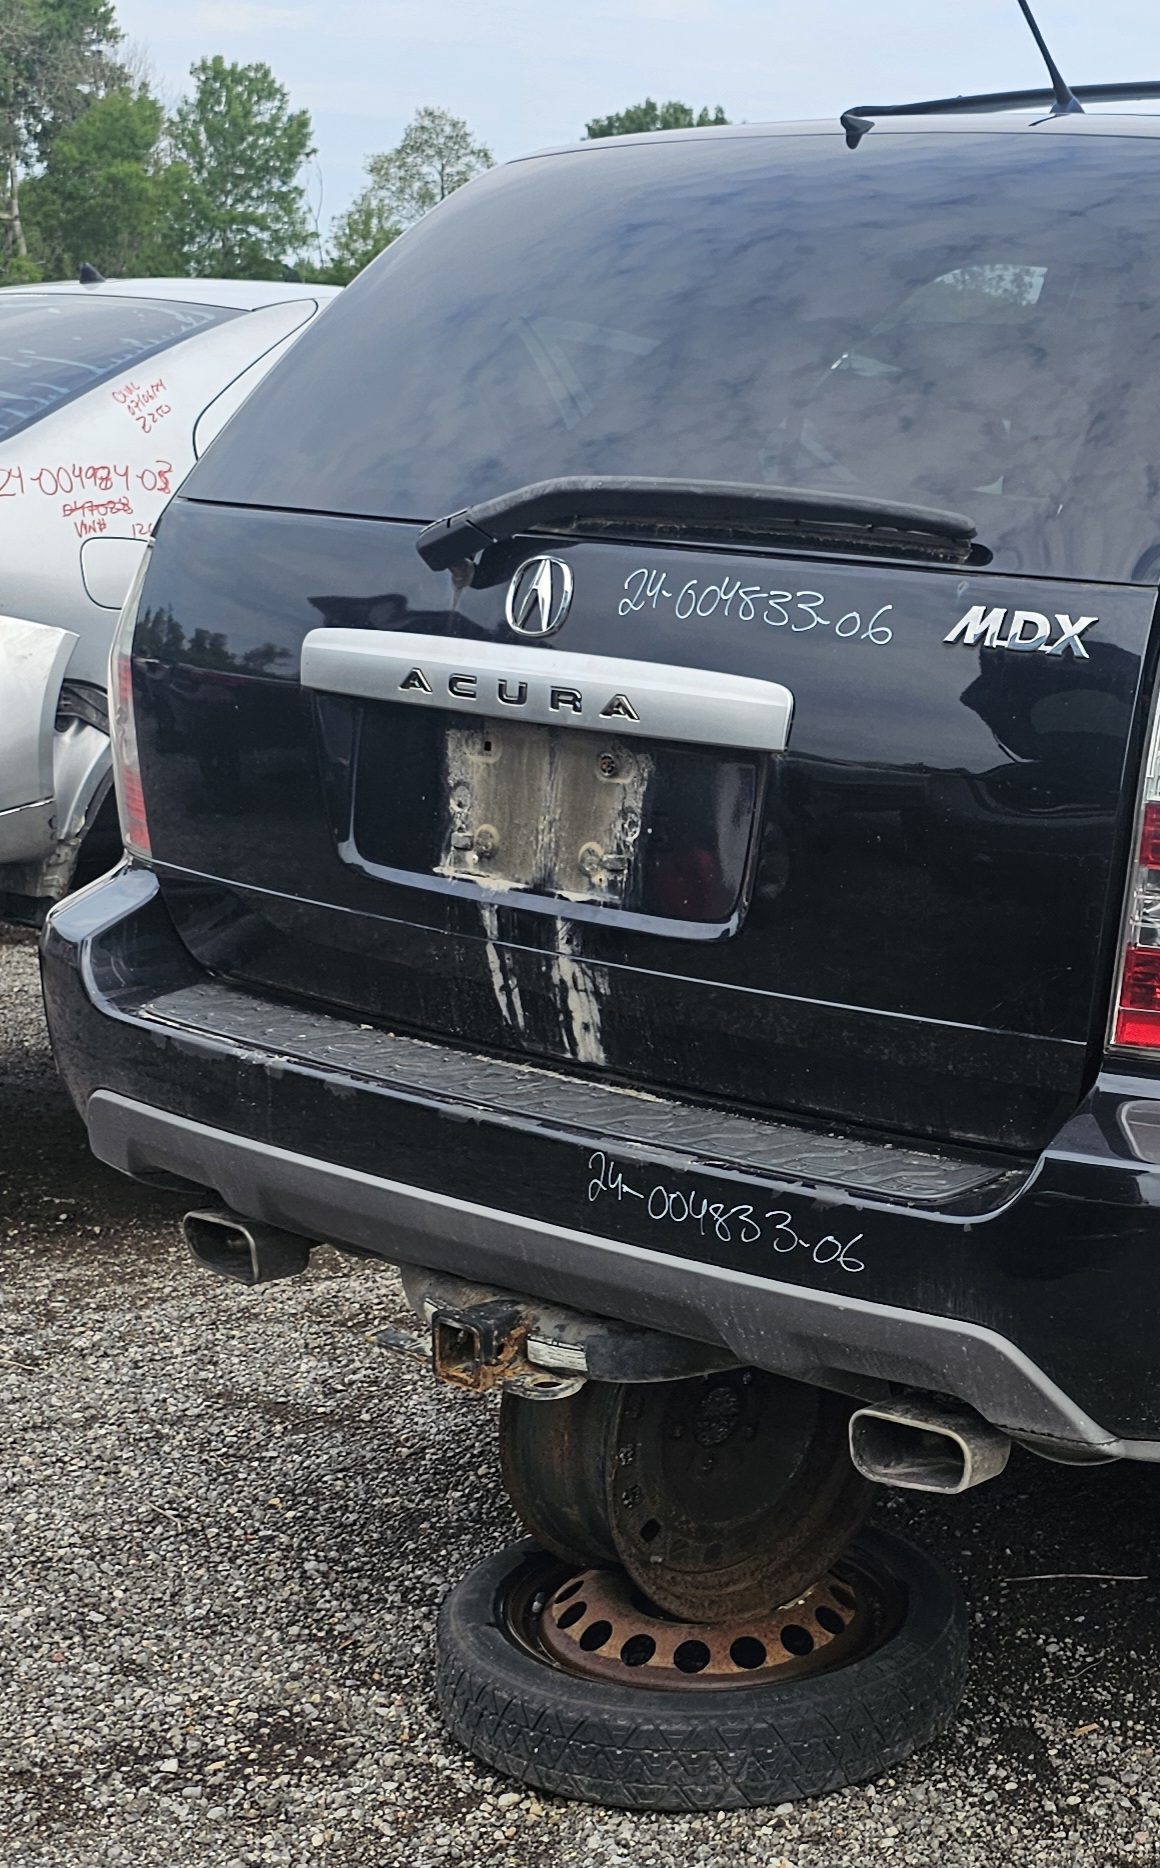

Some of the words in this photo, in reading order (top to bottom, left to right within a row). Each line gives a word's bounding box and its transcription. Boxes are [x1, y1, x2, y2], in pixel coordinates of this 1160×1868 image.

[618, 568, 893, 645] 24-004833-06
[942, 605, 1100, 659] MDX
[398, 667, 641, 722] ACURA
[588, 1152, 865, 1272] 24-004833-06
